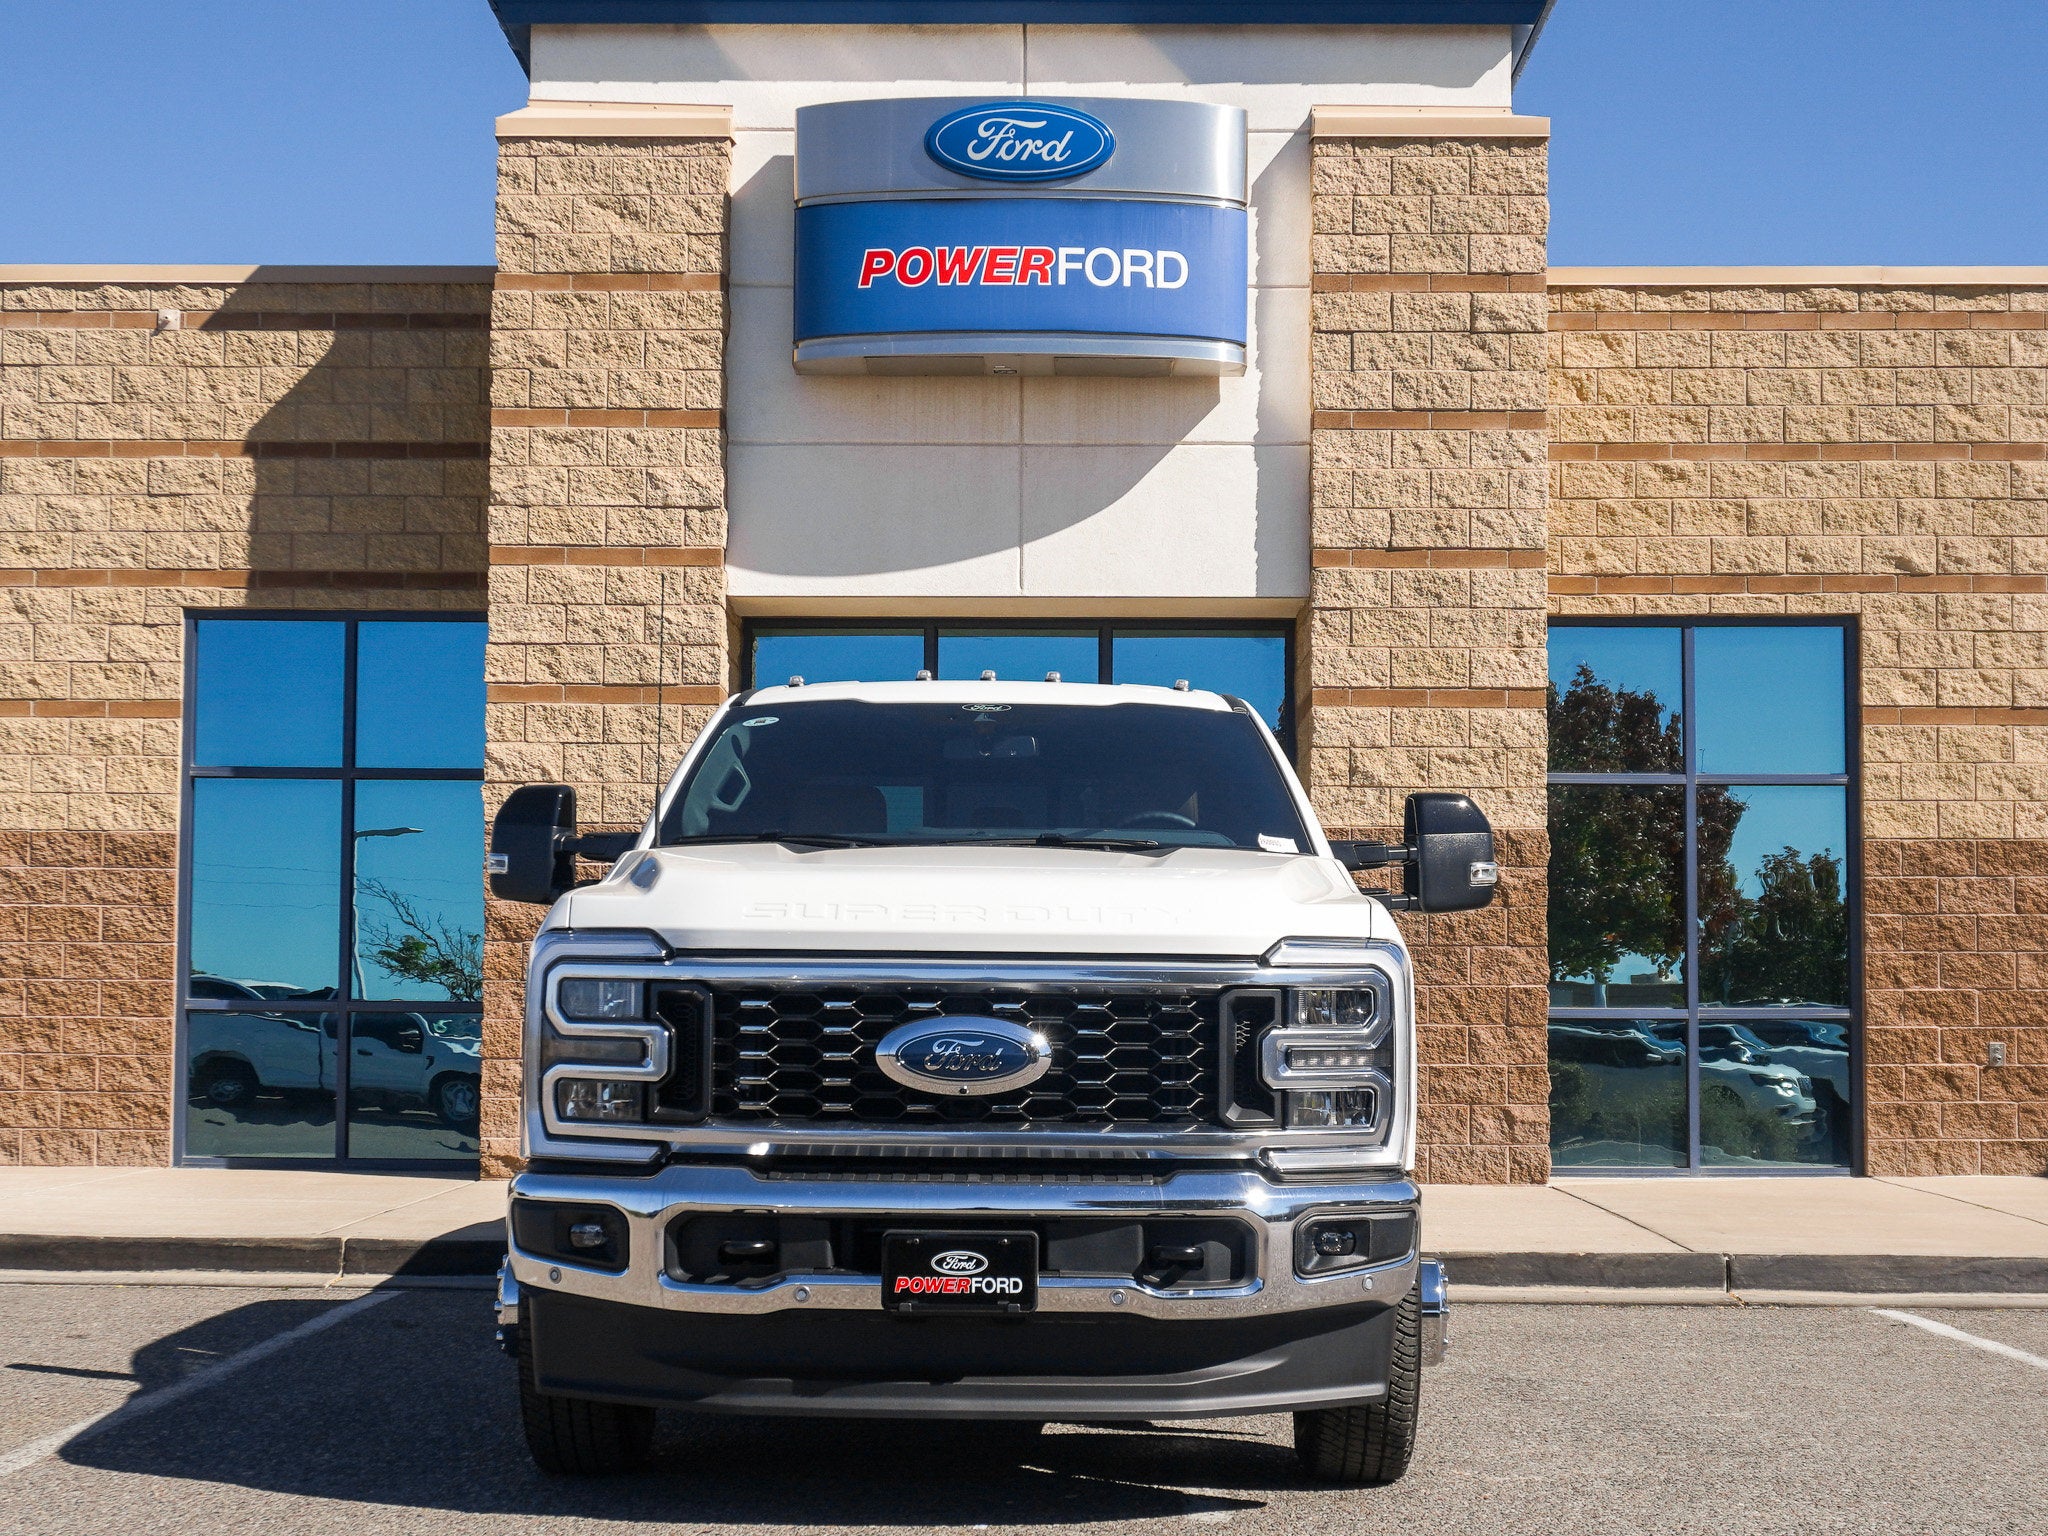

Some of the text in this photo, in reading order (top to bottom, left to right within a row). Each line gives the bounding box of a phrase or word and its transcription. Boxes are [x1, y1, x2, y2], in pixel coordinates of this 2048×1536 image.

[967, 117, 1074, 162] Ford
[742, 902, 1192, 925] SUPER DUTY
[924, 1038, 1004, 1071] Ford
[942, 1255, 976, 1270] Ford
